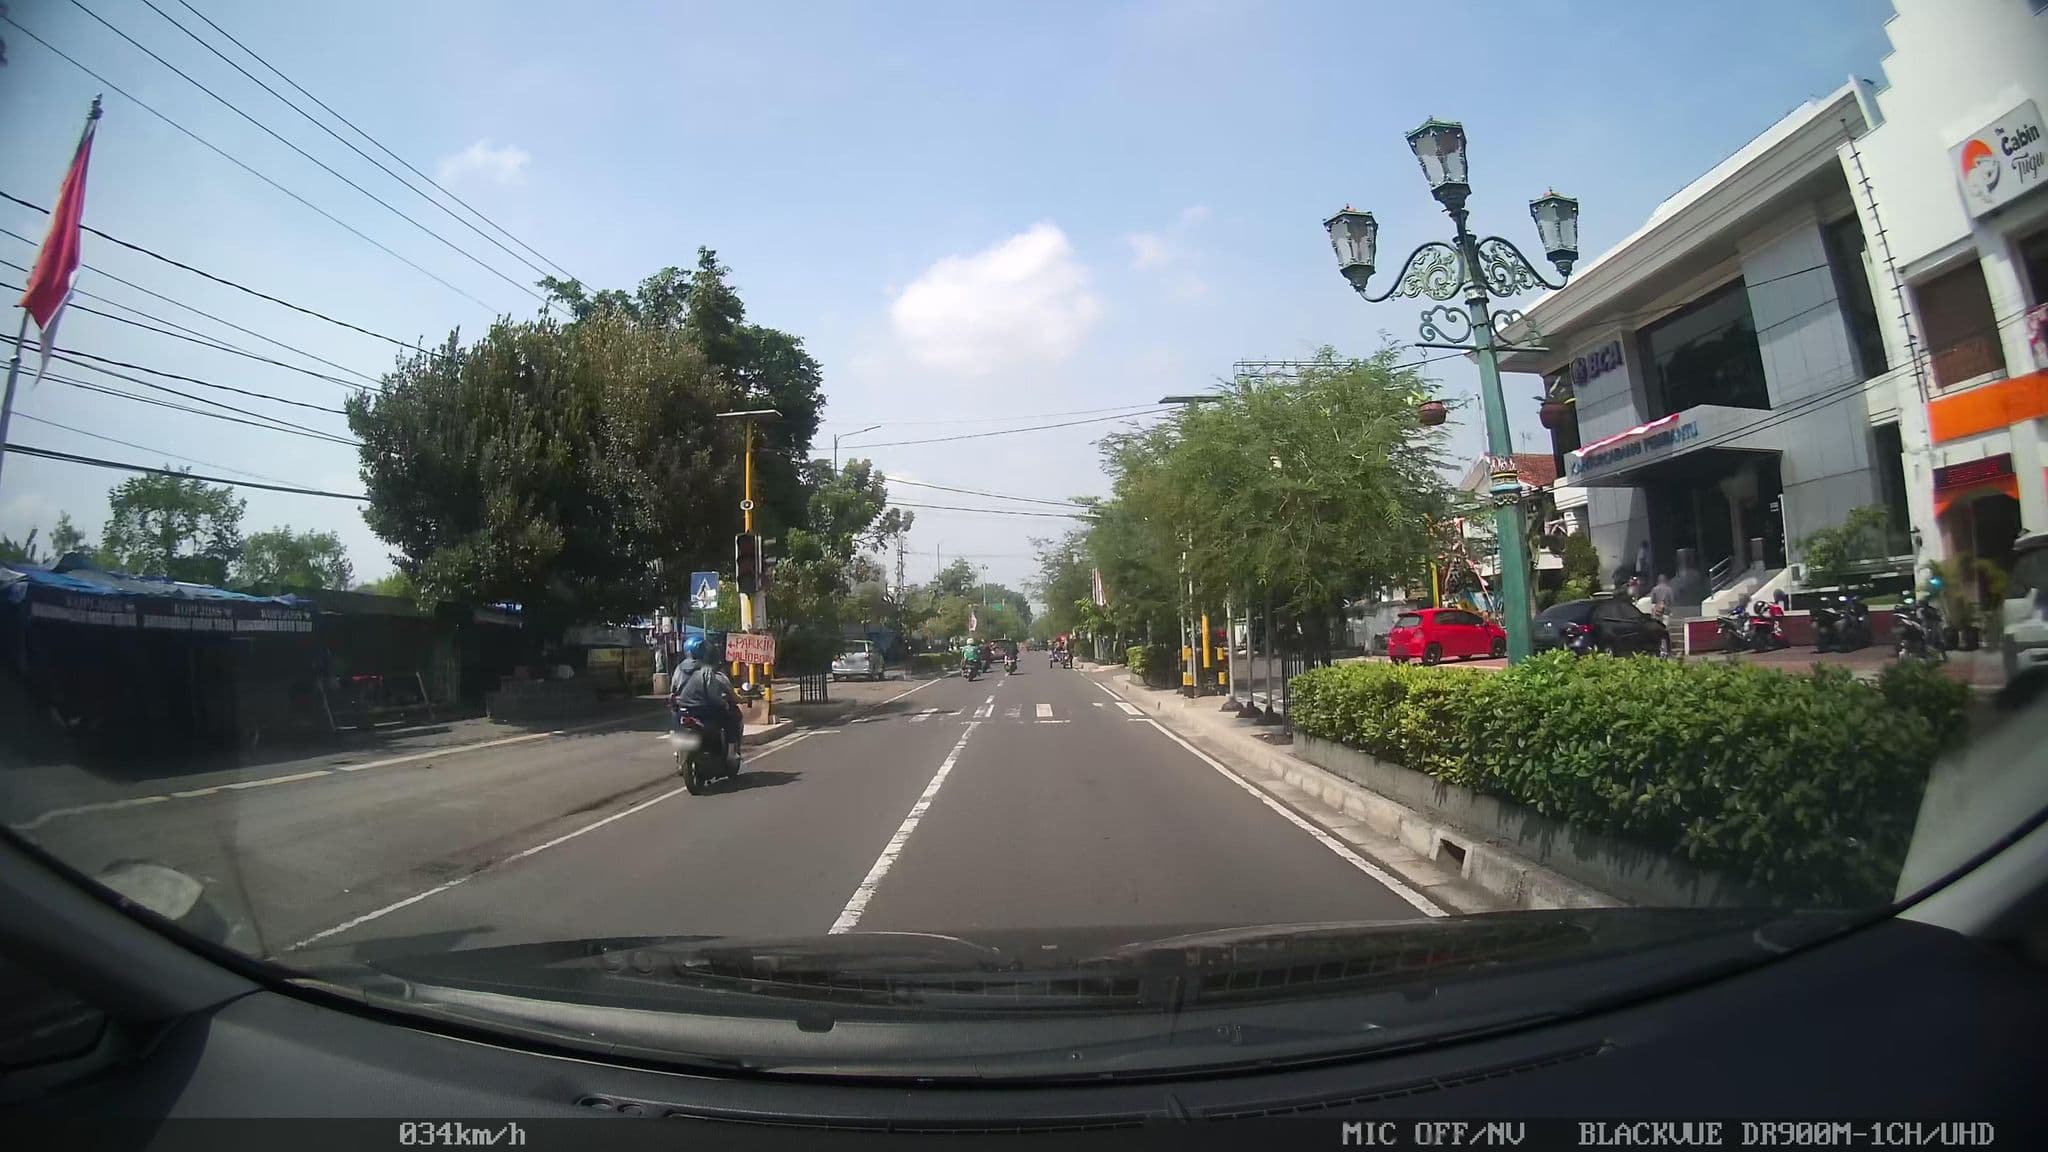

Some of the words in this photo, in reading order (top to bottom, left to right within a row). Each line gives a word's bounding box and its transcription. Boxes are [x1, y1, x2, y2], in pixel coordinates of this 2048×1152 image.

[2001, 124, 2040, 156] Cabin
[2011, 151, 2045, 184] Tugu
[1590, 340, 1624, 379] BCA
